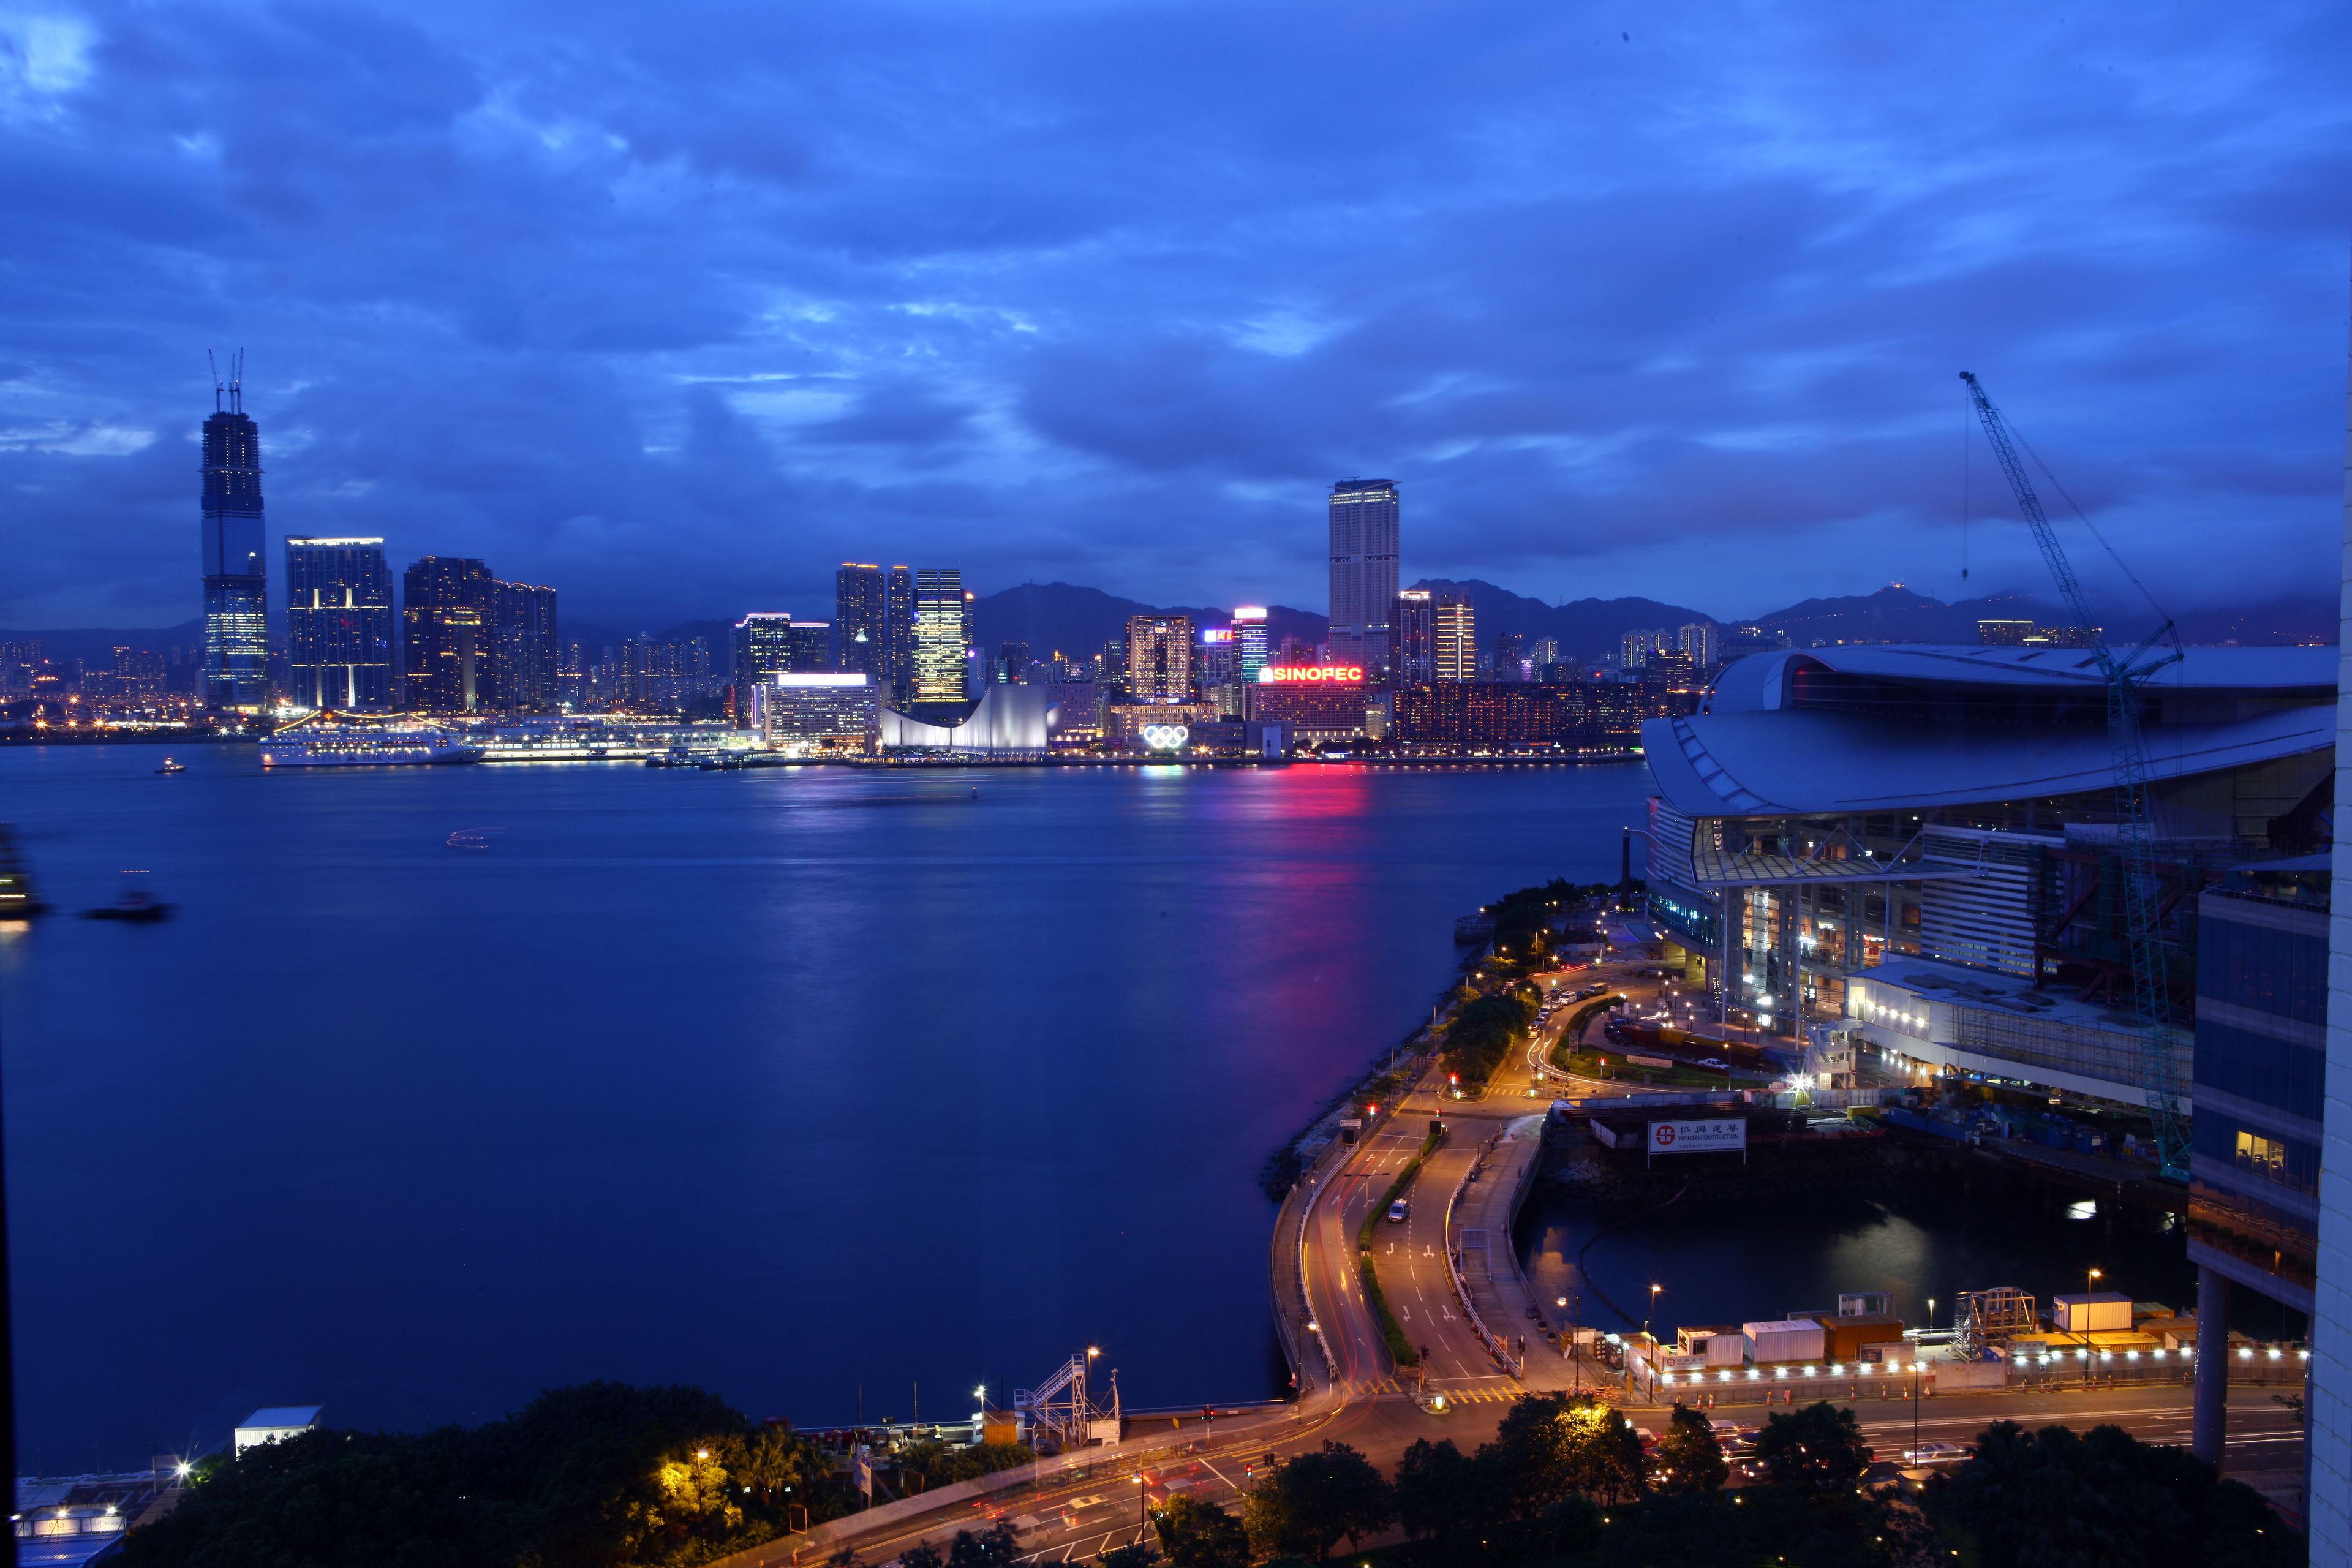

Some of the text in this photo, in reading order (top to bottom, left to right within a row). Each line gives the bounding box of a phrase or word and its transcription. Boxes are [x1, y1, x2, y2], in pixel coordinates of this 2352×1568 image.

[1273, 668, 1362, 680] SINOPEC
[1679, 1124, 1739, 1134] 協興建築
